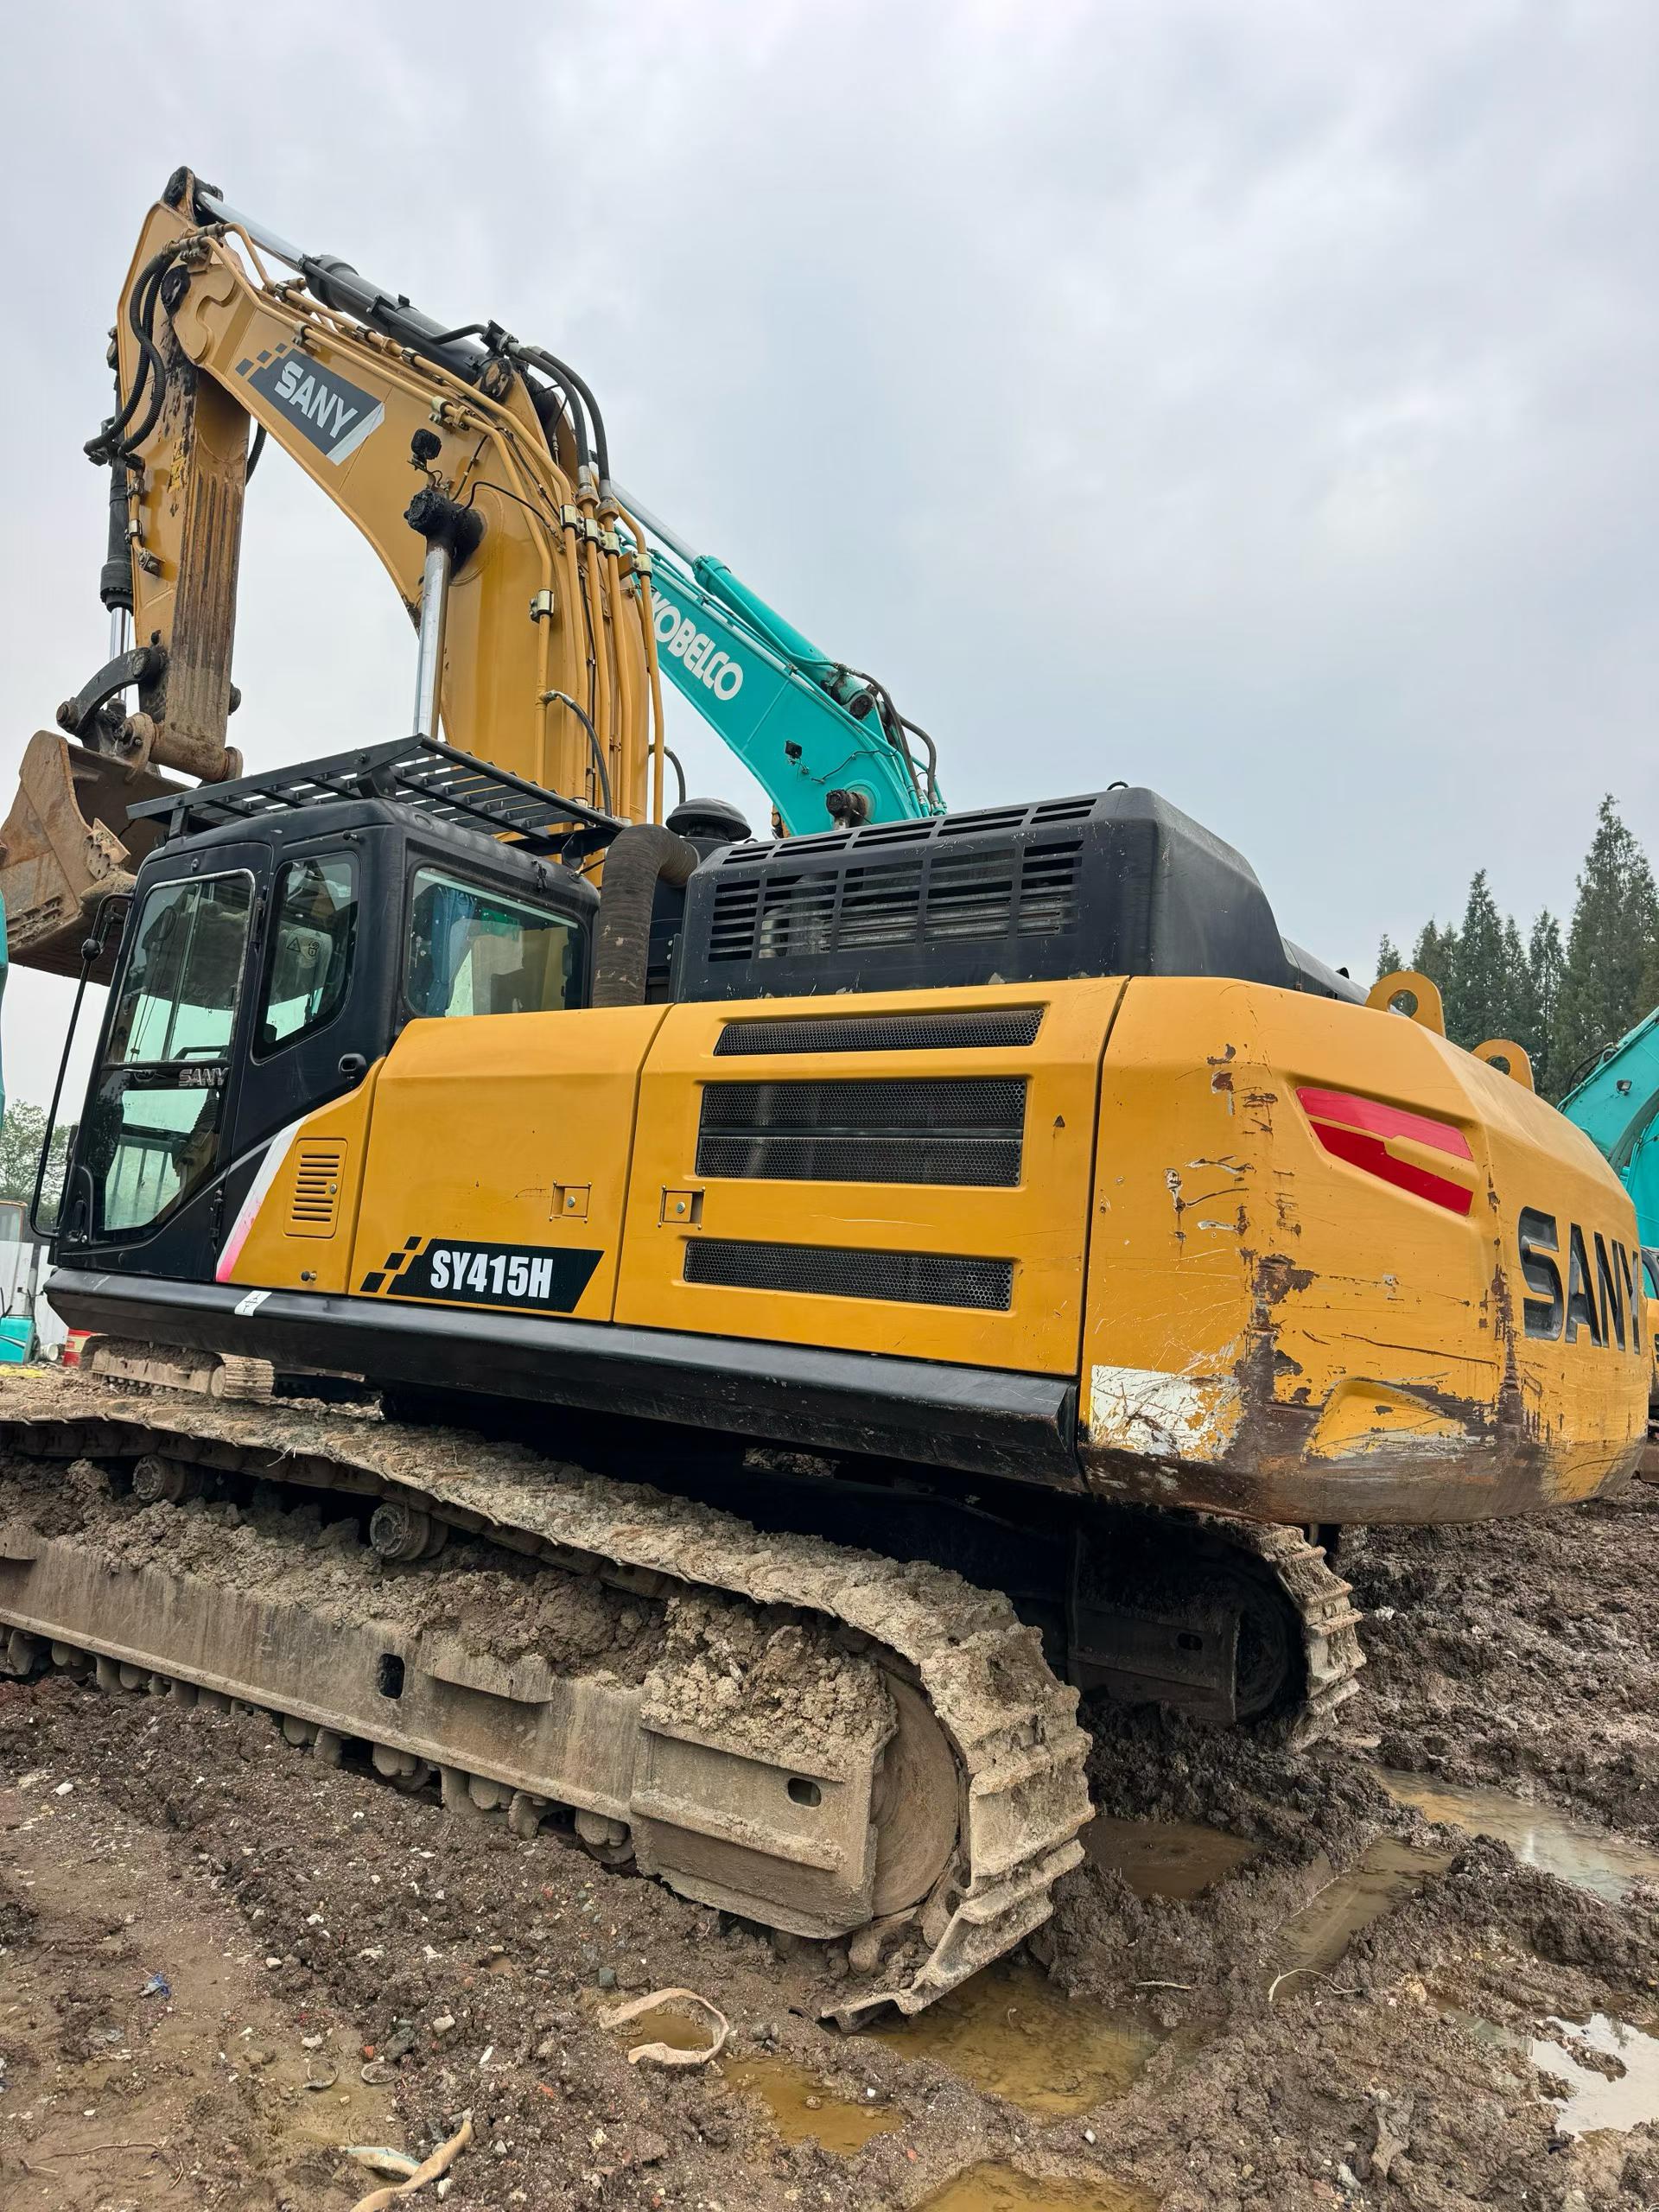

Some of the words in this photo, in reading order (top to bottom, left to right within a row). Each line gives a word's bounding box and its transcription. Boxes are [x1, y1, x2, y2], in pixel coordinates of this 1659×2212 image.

[274, 360, 359, 439] SANY
[179, 1067, 230, 1087] SANY
[430, 1249, 554, 1299] SY415H
[1518, 1205, 1640, 1355] SANY
